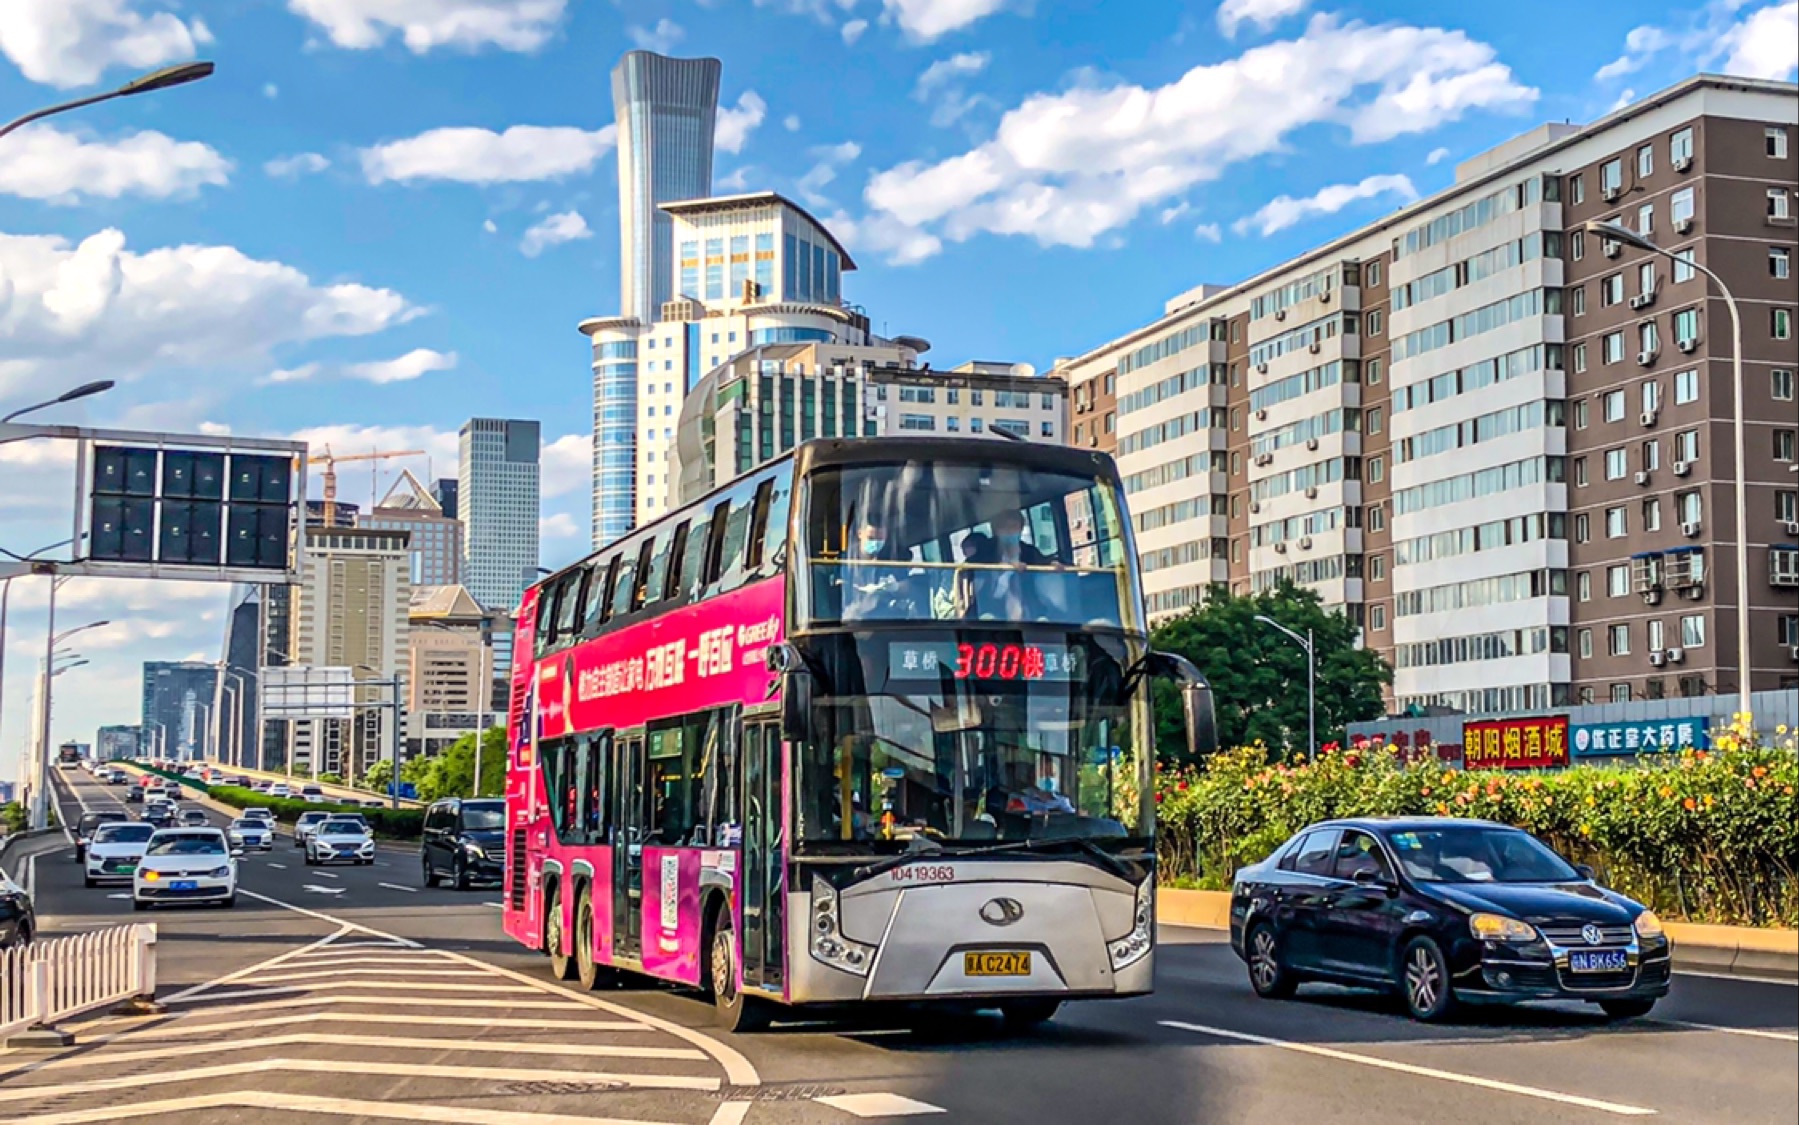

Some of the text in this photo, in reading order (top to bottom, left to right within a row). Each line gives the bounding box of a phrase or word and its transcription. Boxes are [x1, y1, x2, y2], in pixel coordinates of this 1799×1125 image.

[902, 650, 937, 670] 草桥
[1465, 724, 1566, 760] 朝阳烟酒城
[889, 865, 955, 881] 10419363
